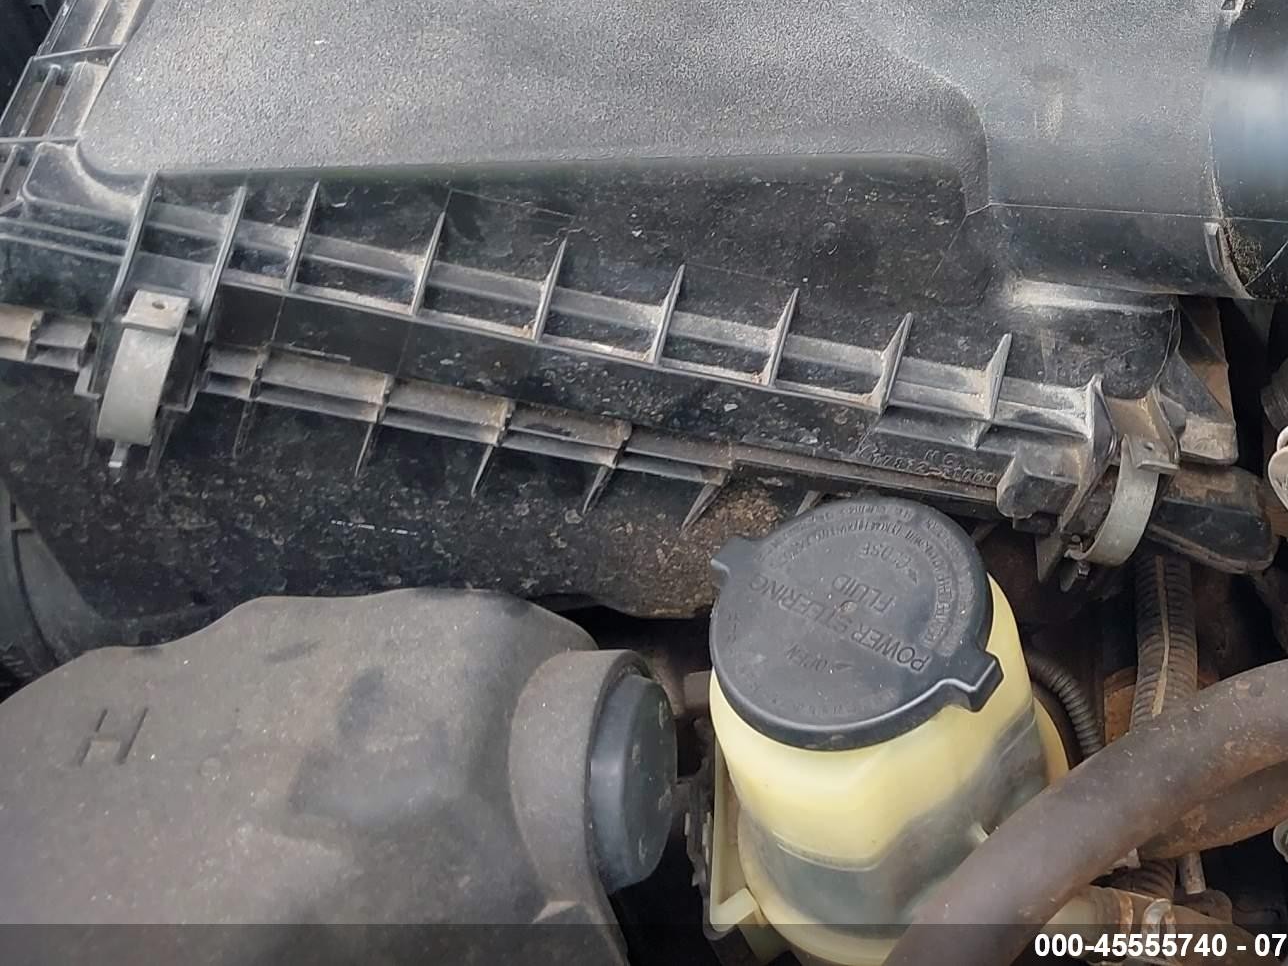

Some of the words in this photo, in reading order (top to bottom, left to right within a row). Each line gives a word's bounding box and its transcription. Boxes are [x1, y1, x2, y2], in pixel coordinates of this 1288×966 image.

[748, 574, 853, 640] STEERING
[831, 574, 899, 615] FLUID
[787, 643, 829, 674] OPEN
[852, 624, 931, 674] POWER
